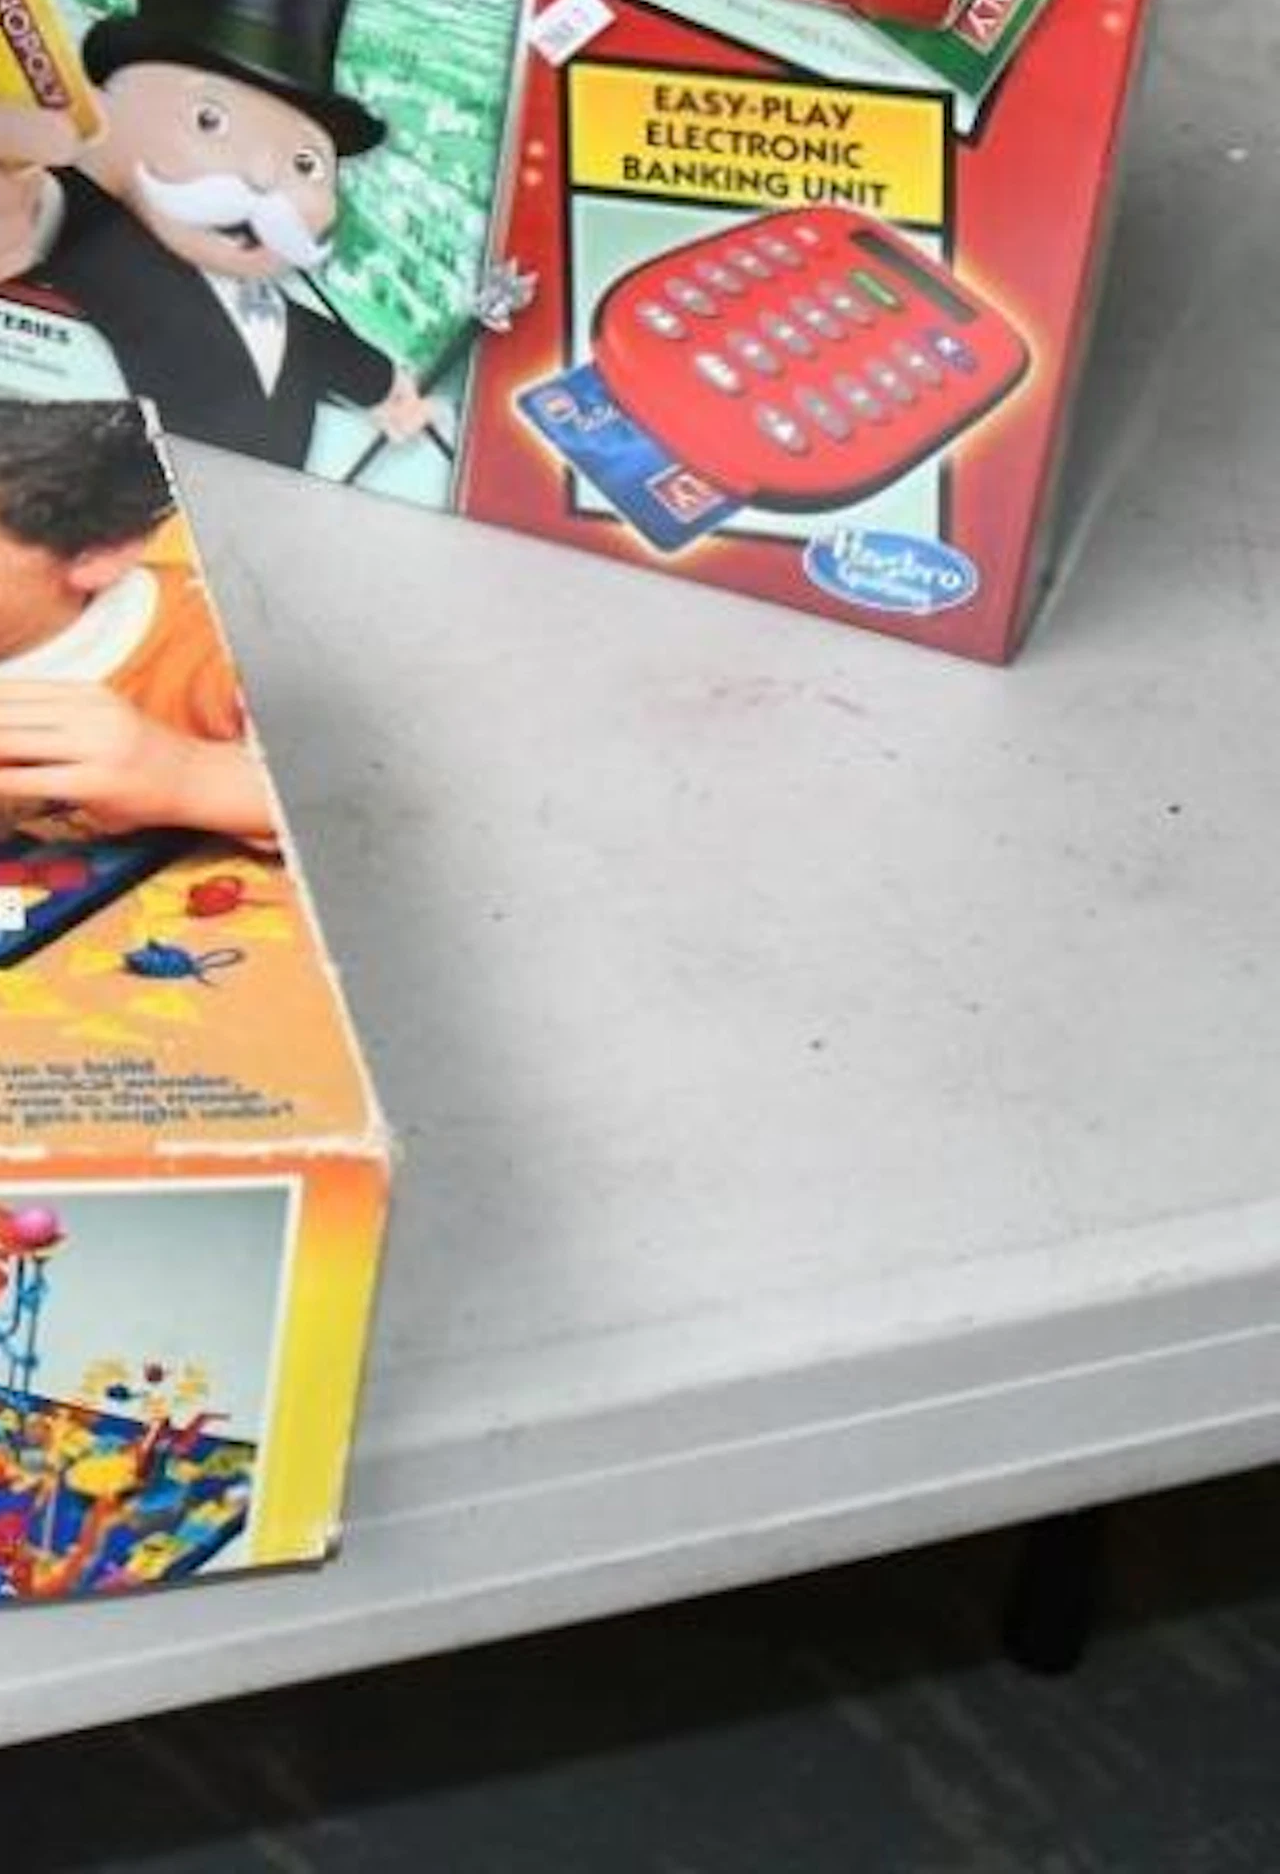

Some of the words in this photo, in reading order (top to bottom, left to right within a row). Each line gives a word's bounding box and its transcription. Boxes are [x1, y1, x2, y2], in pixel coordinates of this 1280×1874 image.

[653, 84, 856, 131] EASY-PLAY
[644, 120, 864, 172] ELECTRONIC
[621, 154, 790, 202] BANKING
[801, 178, 889, 209] UNIT
